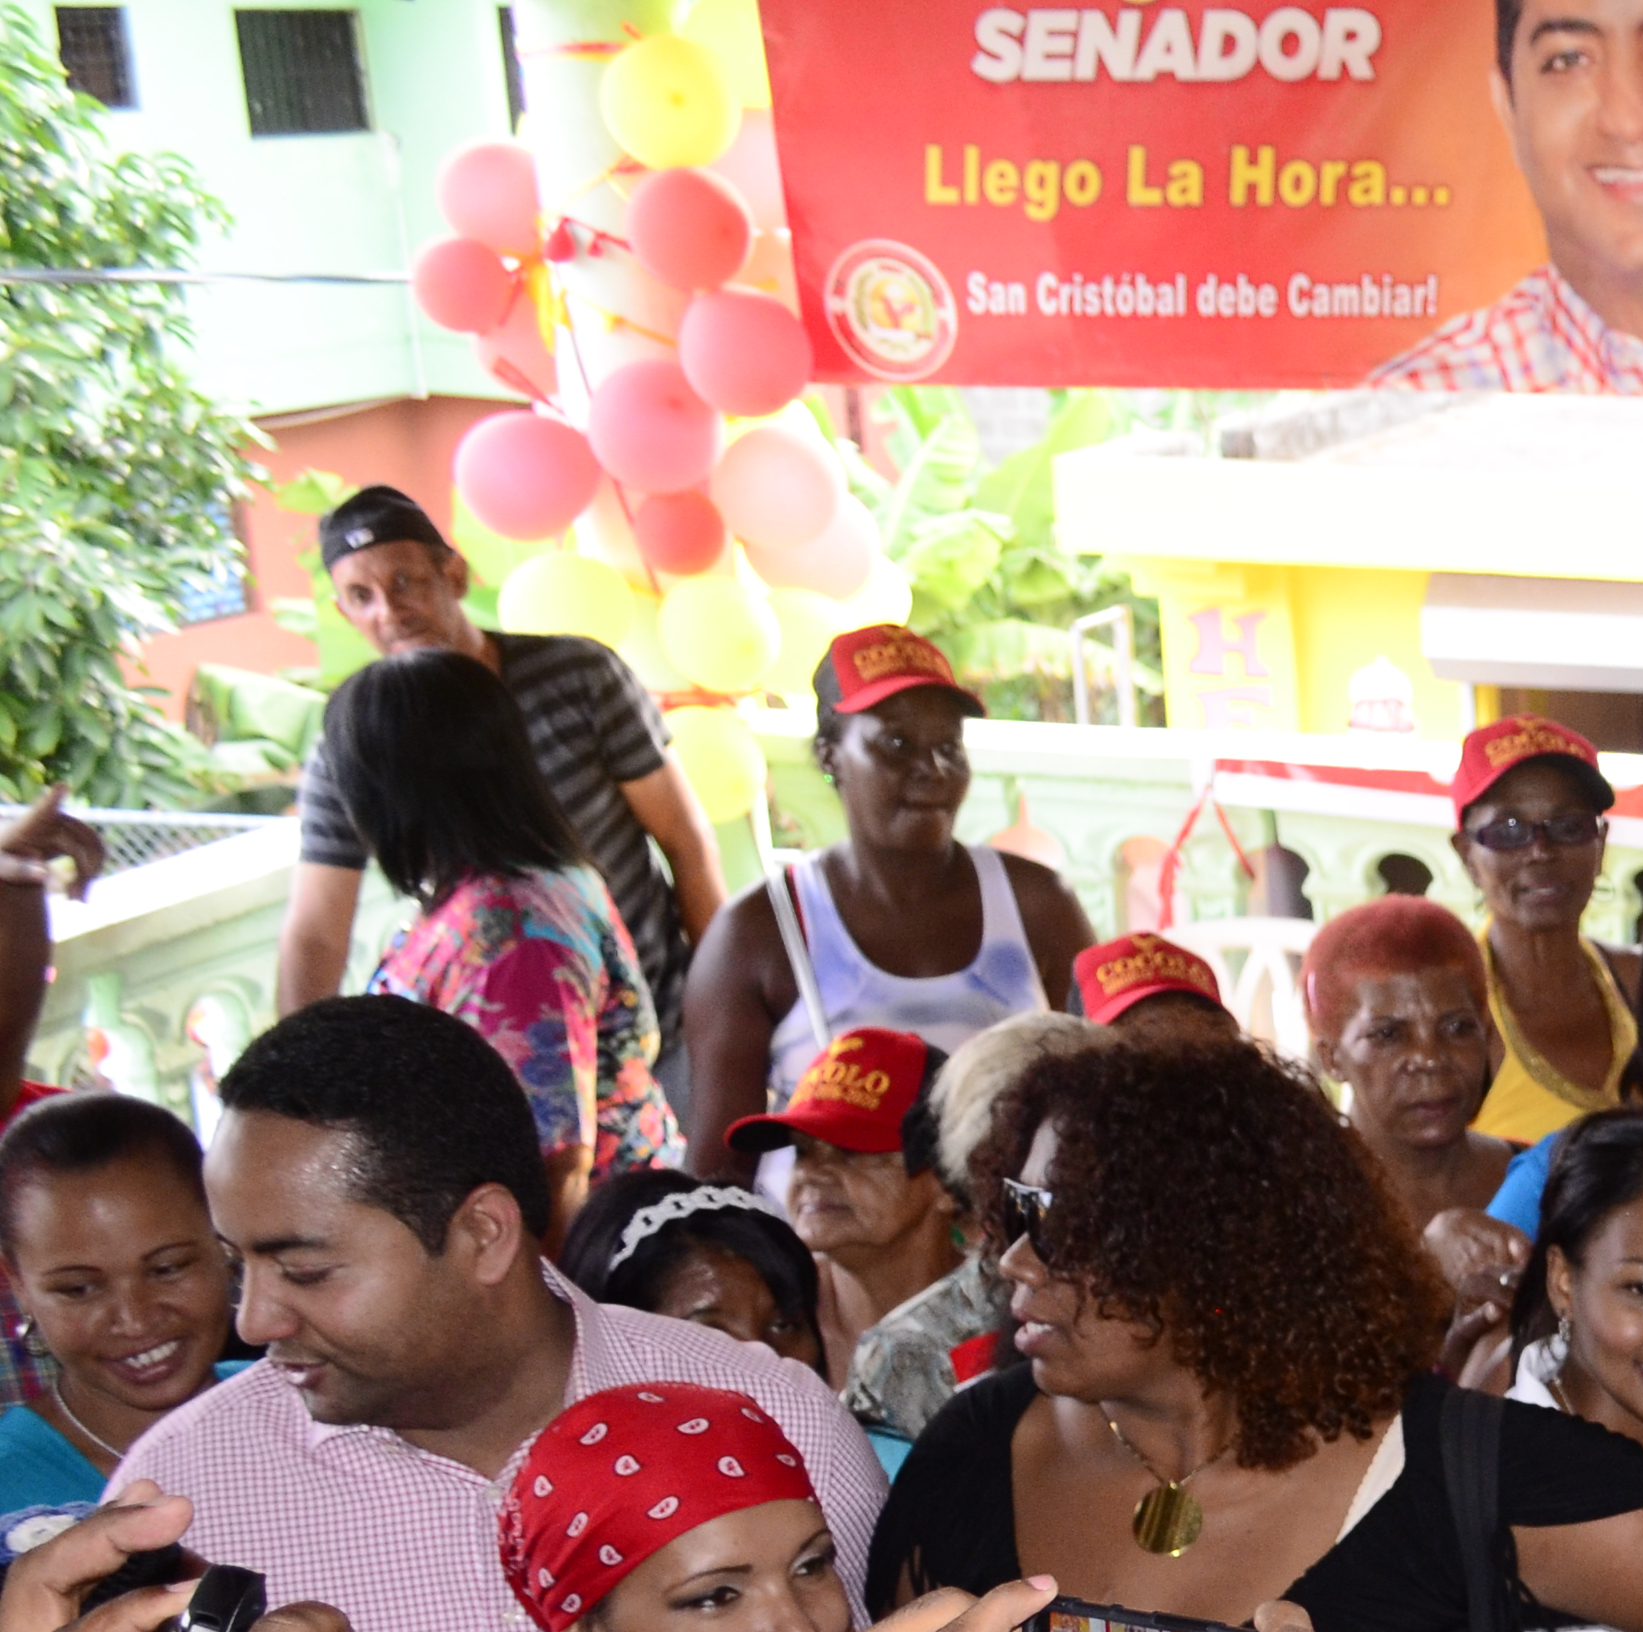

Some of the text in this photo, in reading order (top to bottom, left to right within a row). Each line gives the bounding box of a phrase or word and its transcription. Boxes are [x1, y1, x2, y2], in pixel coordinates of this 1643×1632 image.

[971, 7, 1381, 83] SENADOR
[923, 142, 1452, 222] Llego La Hora...
[966, 270, 1440, 320] San Cristóbal debe Cambiar!
